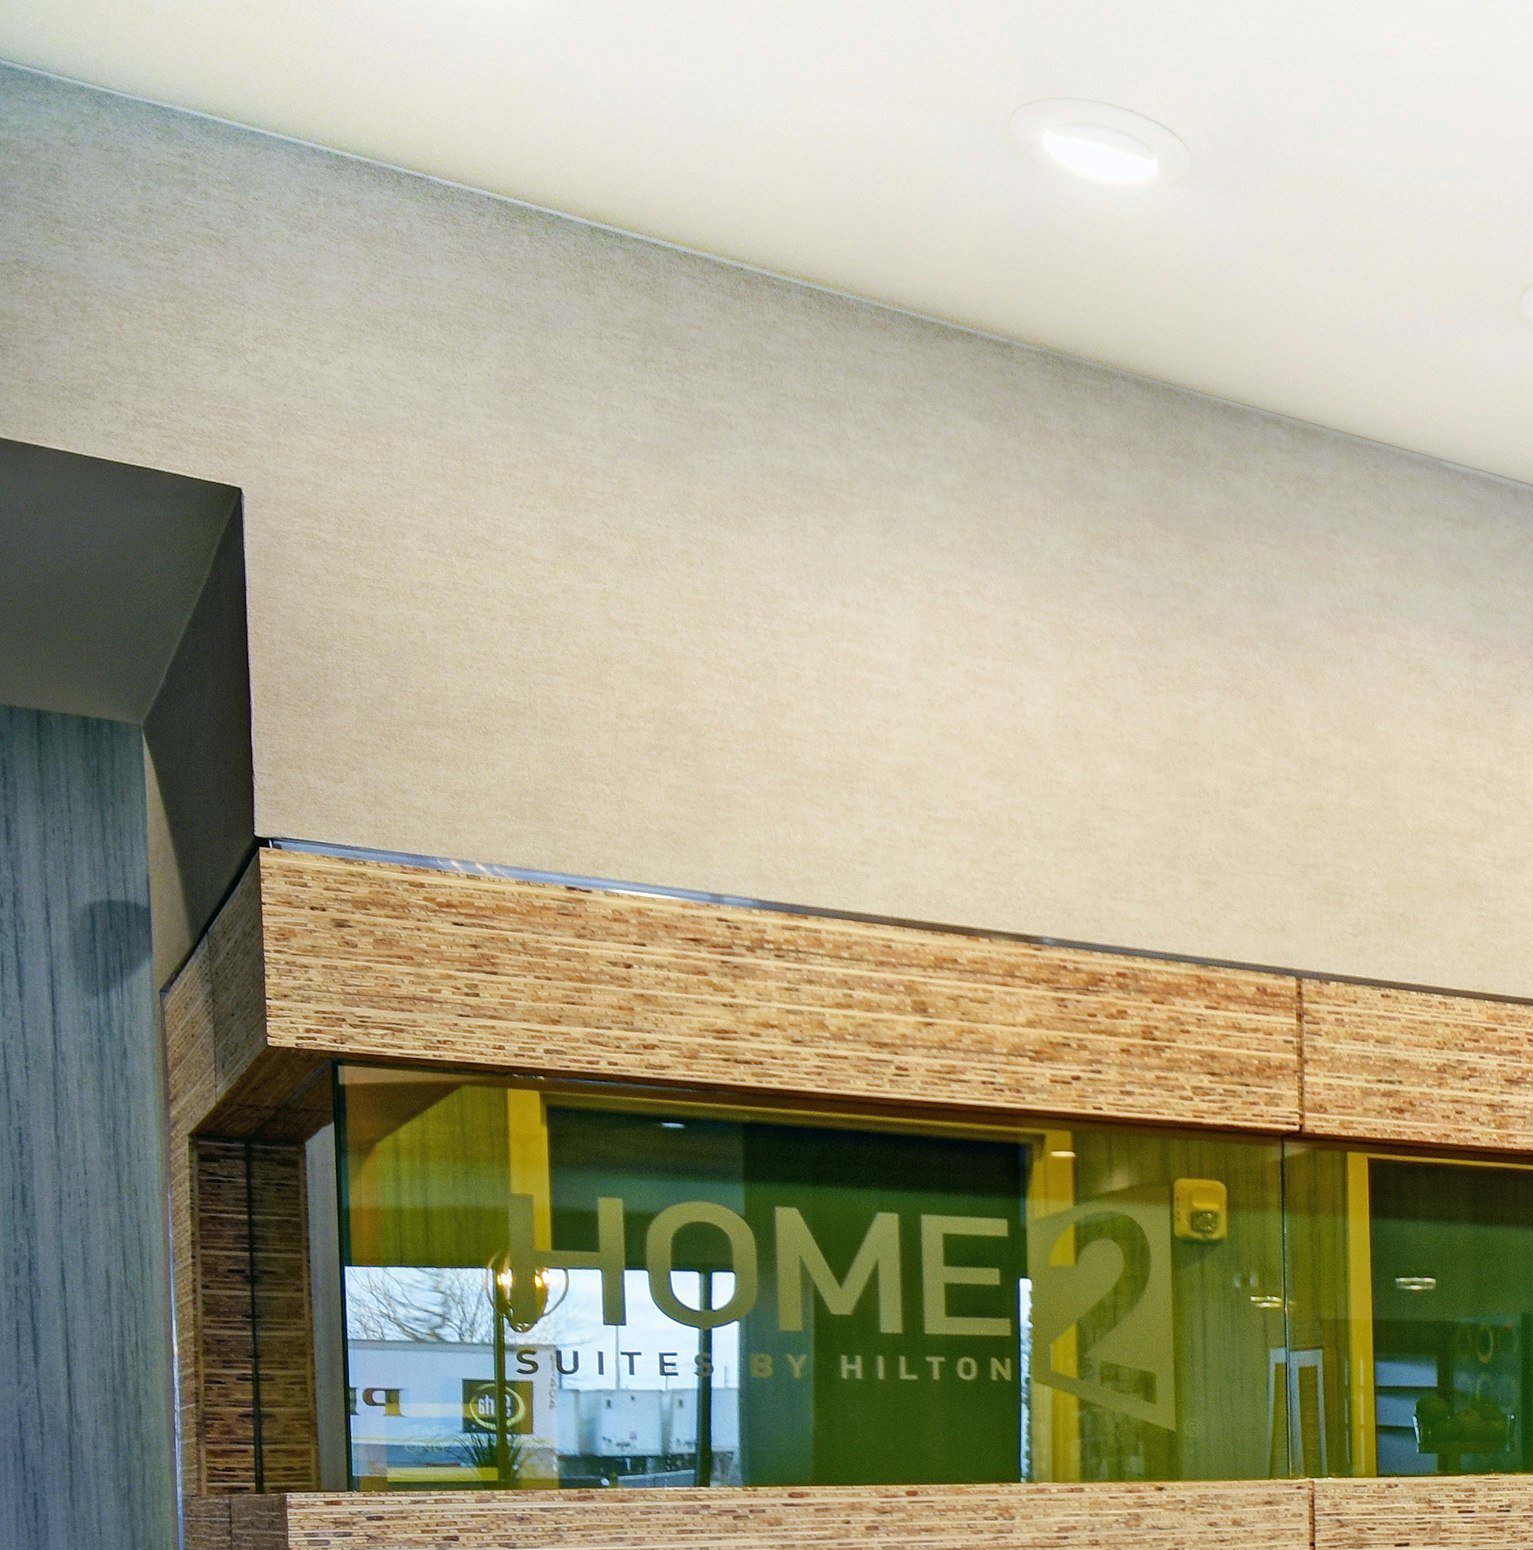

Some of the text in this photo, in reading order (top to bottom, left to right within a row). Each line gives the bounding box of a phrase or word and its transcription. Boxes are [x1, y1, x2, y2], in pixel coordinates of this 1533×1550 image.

[516, 1350, 1013, 1382] SUITES BY HILTON
